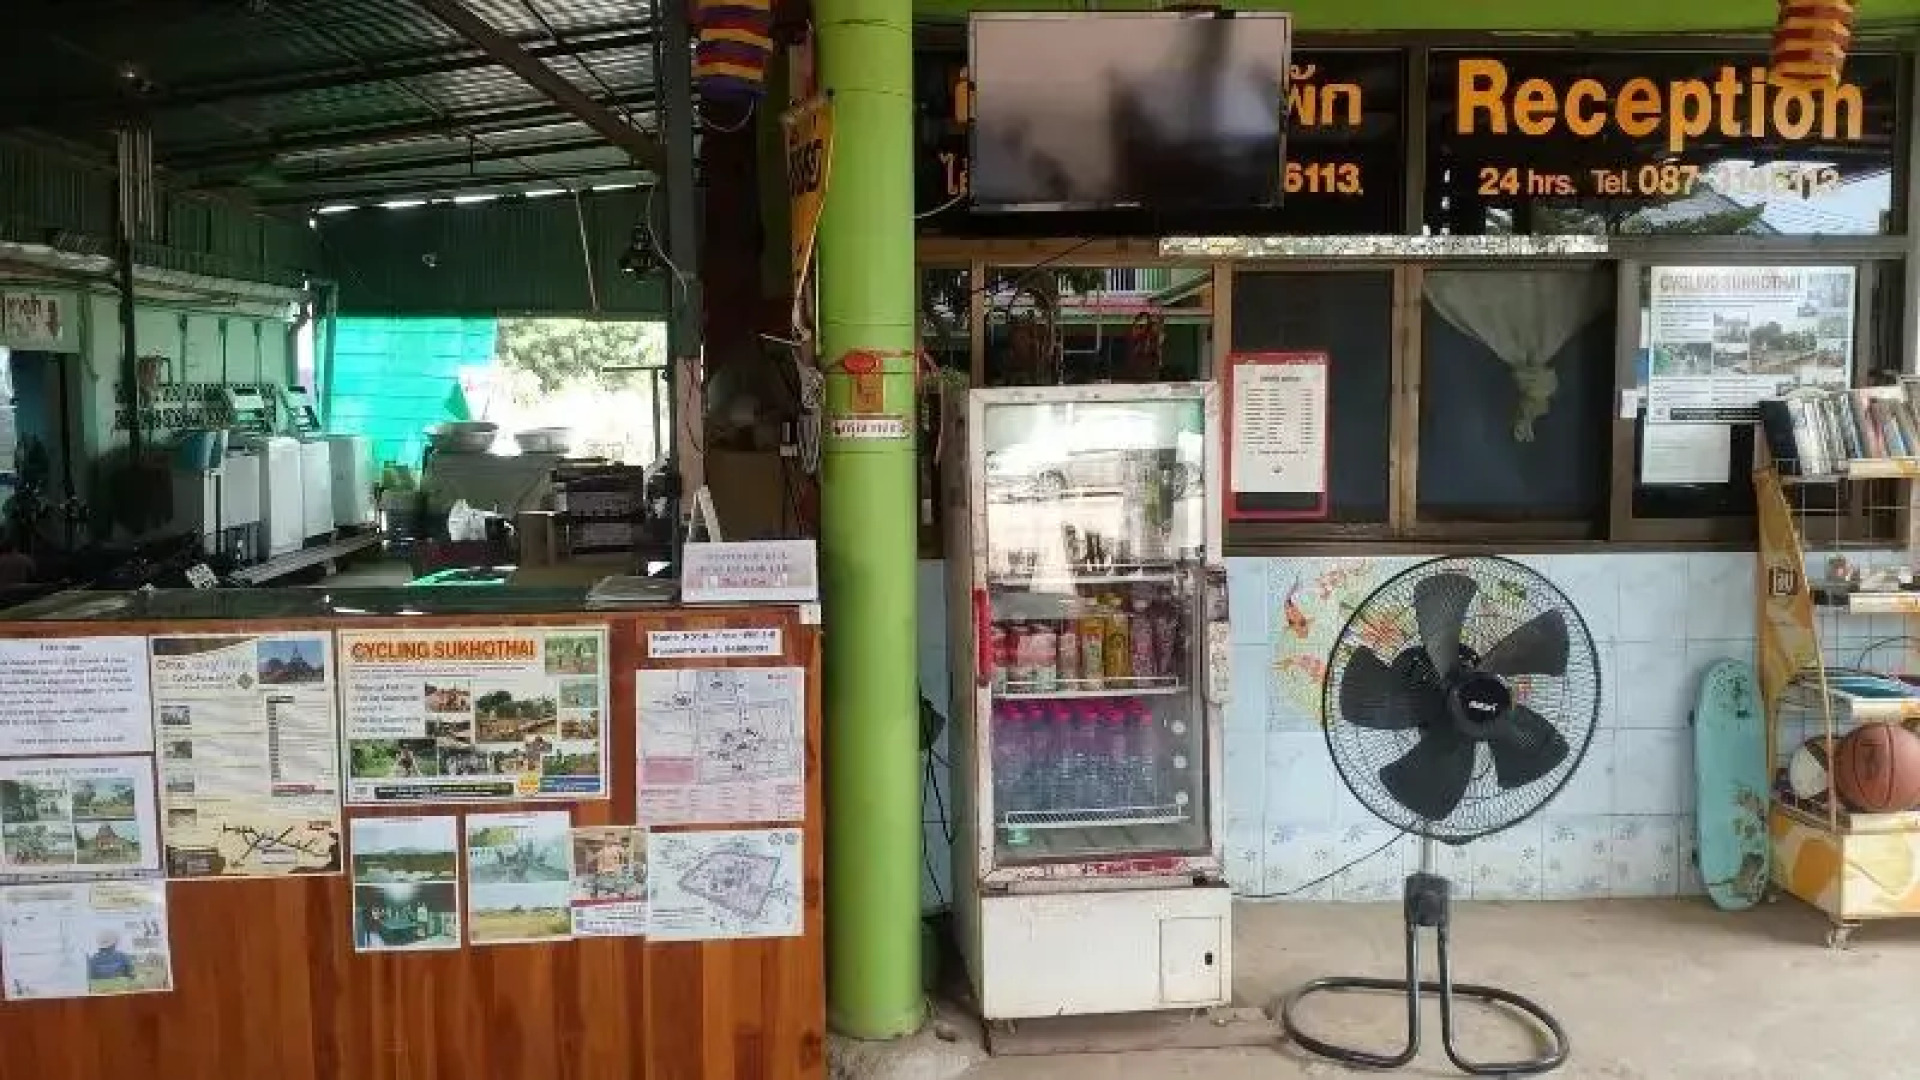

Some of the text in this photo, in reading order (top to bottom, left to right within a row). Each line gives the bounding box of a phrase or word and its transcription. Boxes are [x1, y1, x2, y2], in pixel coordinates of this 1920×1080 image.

[1457, 59, 1863, 151] Reception
[1478, 167, 1519, 195] 24
[1528, 169, 1577, 195] hrs.
[1591, 169, 1632, 194] Tel.
[351, 640, 535, 660] CYCLING SUKHOTHAI
